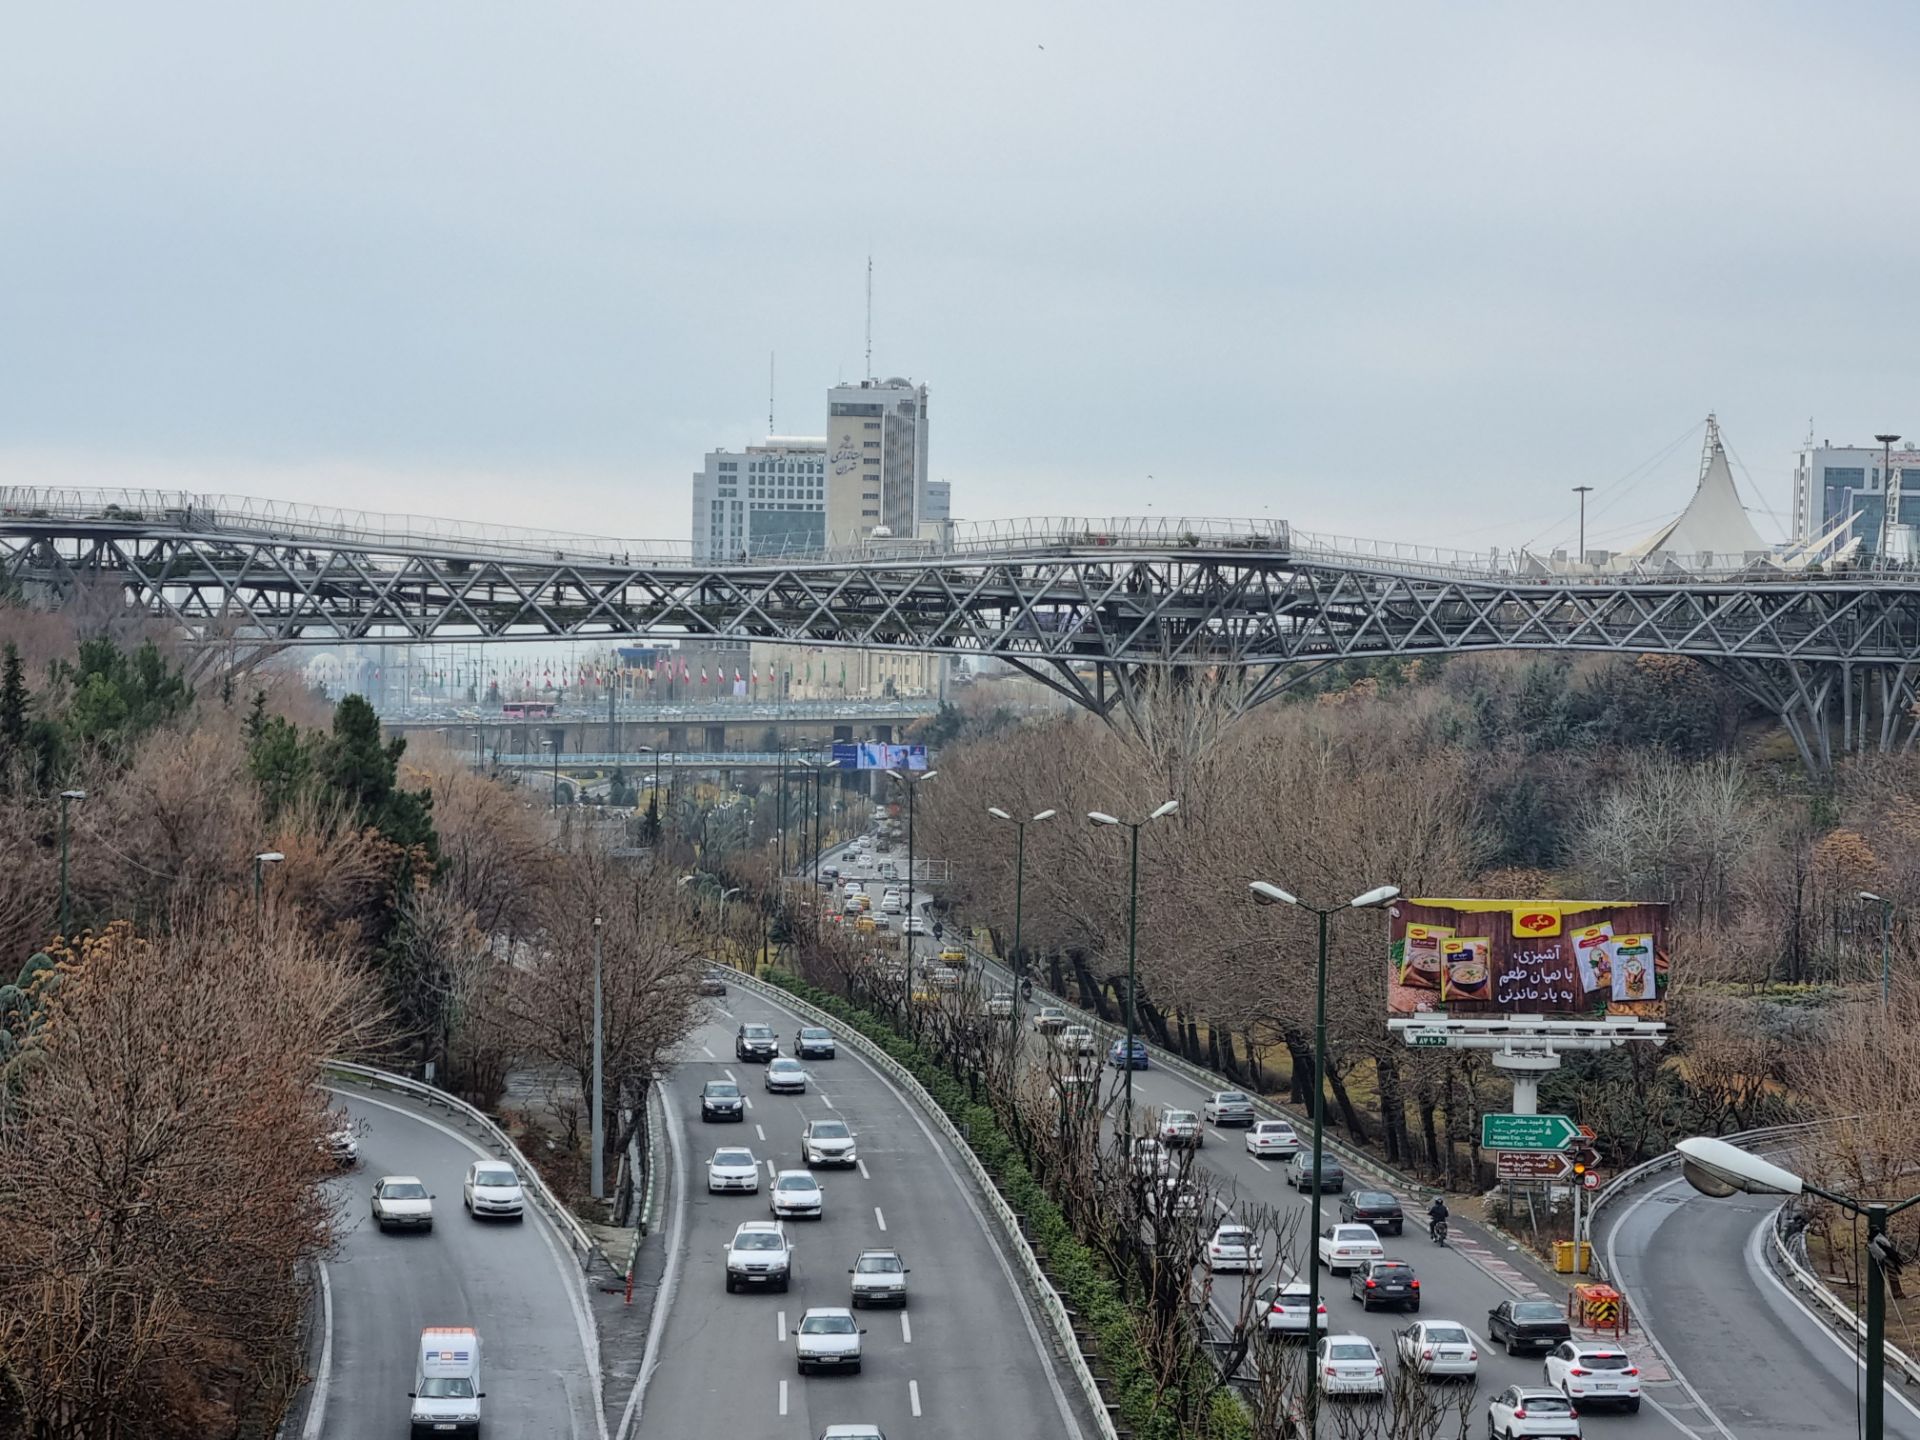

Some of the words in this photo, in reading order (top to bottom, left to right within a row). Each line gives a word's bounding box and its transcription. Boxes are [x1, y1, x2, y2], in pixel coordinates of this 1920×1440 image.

[1528, 915, 1549, 929] مگی
[1499, 966, 1528, 987] طعم
[1530, 967, 1561, 984] همان
[1564, 967, 1573, 983] با
[1498, 987, 1538, 1003] ماندنی
[1541, 987, 1558, 1003] یاد
[1560, 990, 1573, 1003] به
